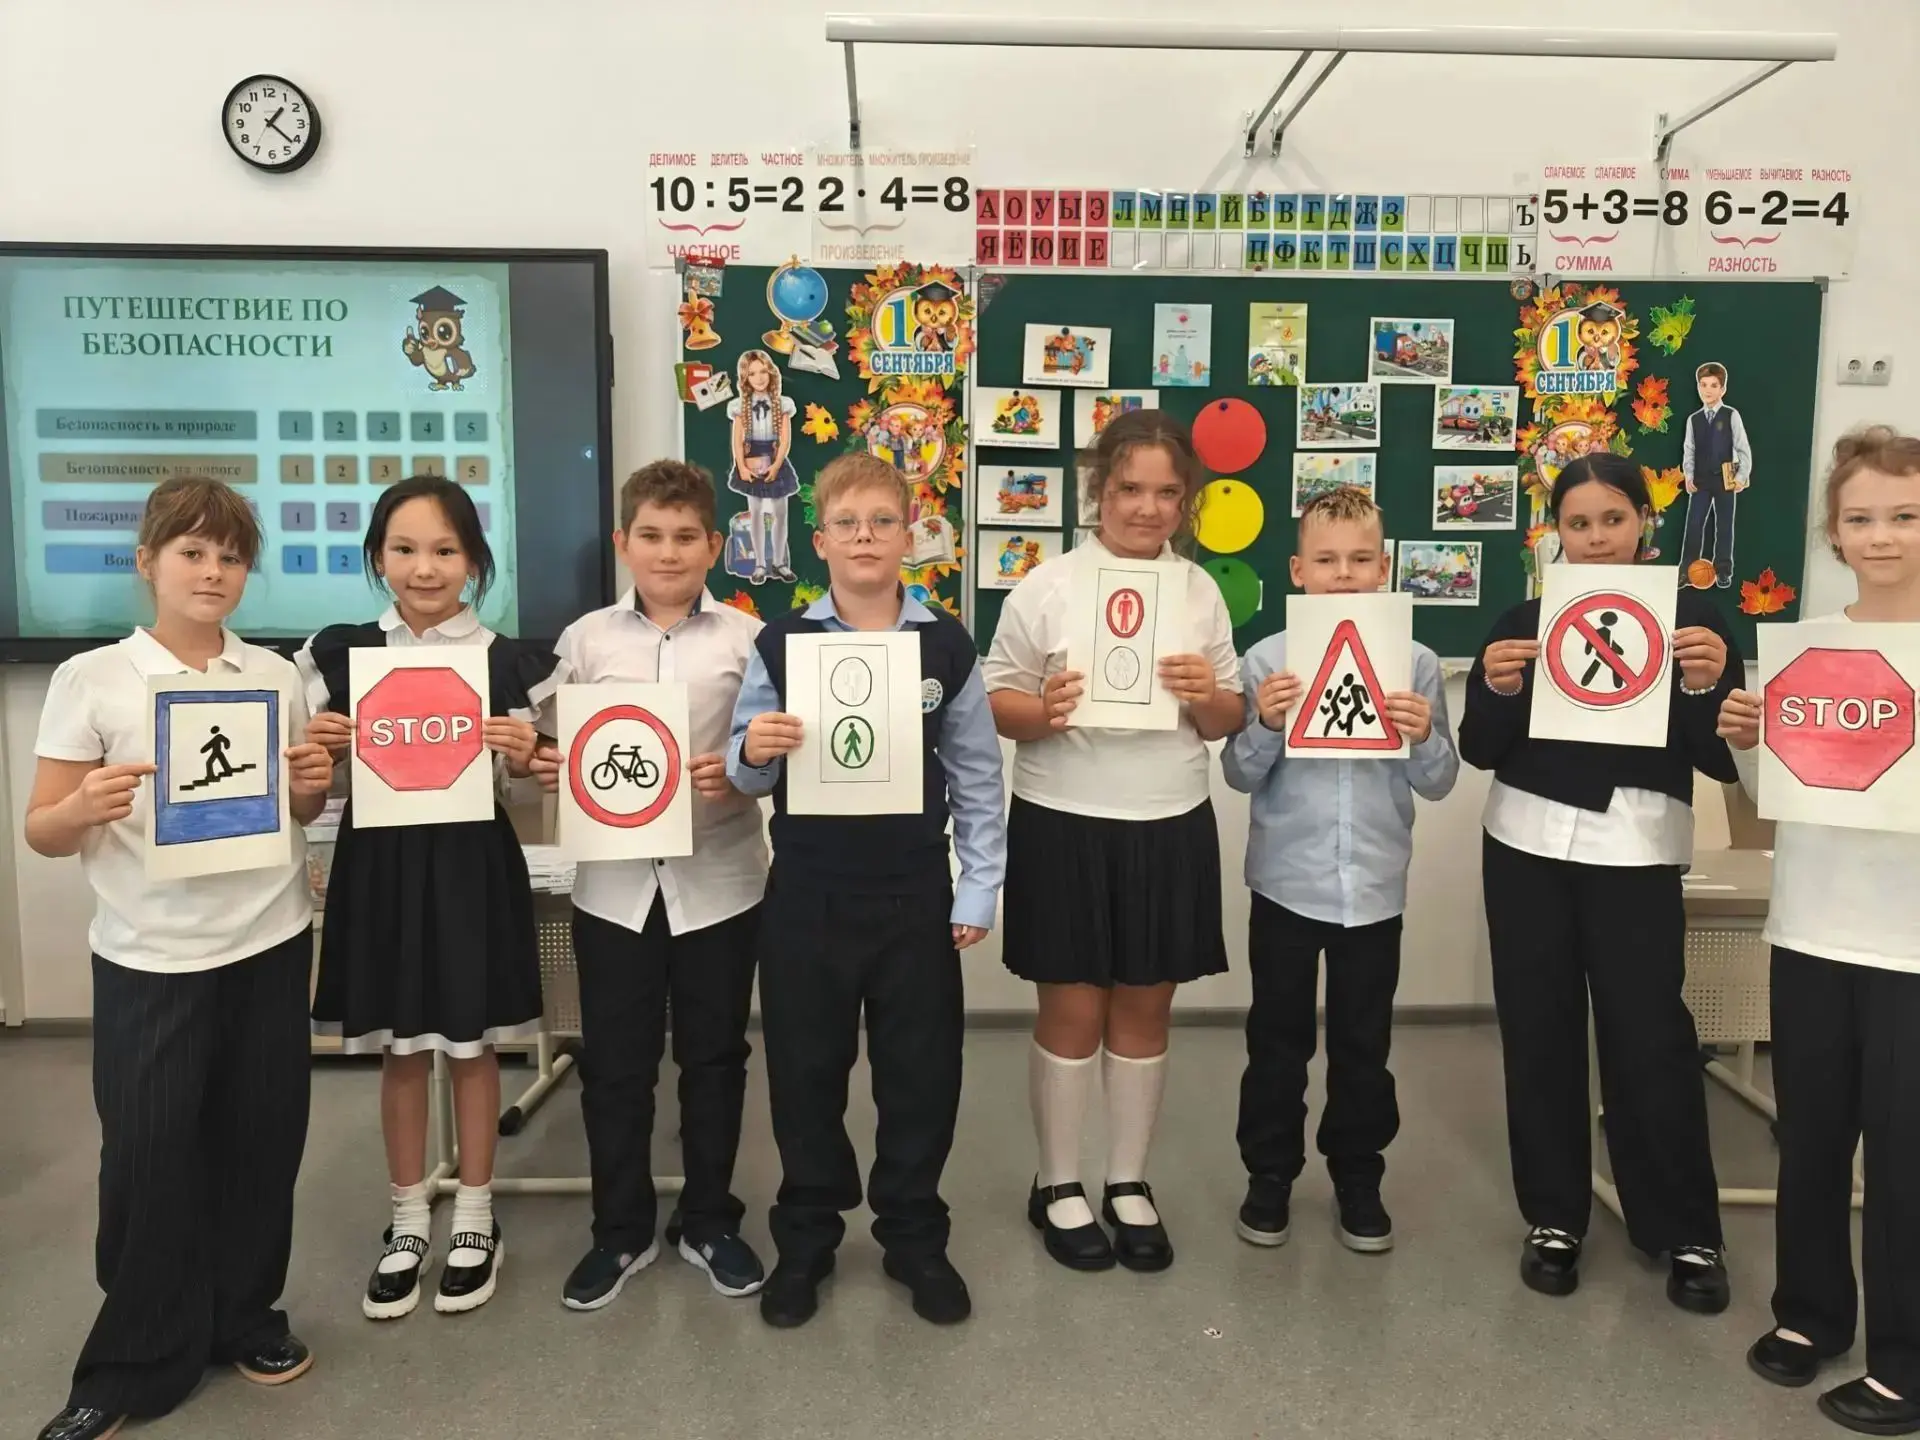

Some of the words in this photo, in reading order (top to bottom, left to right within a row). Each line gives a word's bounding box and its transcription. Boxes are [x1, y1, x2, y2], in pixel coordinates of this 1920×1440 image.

[249, 92, 258, 102] 11
[262, 88, 276, 98] 12
[282, 92, 287, 102] 1
[239, 103, 252, 112] 10
[292, 103, 300, 112] 2
[236, 119, 244, 128] 9
[296, 119, 305, 128] 3
[241, 134, 249, 143] 8
[293, 135, 301, 144] 4
[253, 146, 260, 155] 7
[268, 150, 276, 159] 6
[283, 146, 292, 155] 5
[649, 153, 696, 167] ДЕЛИМОЕ
[711, 153, 748, 166] ДЕЛИТЕЛЬ
[761, 153, 804, 166] ЧАСТНОЕ
[1544, 166, 1586, 179] СЛАГАЕМОЕ
[1594, 166, 1636, 180] СЛАГАЕМОЕ
[1660, 168, 1689, 181] СУММА
[1760, 168, 1802, 181] ВЫЧИТАЕМОЕ
[1811, 169, 1851, 182] РАЗНОСТЬ
[979, 197, 998, 219] А
[1006, 197, 1022, 219] О
[1034, 197, 1051, 220] У
[1058, 197, 1081, 220] Ы
[1090, 197, 1105, 221] Э
[1114, 199, 1133, 221] Л
[1142, 199, 1162, 222] М
[1168, 199, 1187, 222] Н
[1195, 200, 1211, 222] Р
[1223, 196, 1241, 223] Й
[1250, 201, 1265, 224] Б
[1279, 201, 1294, 224] В
[1305, 201, 1320, 224] Г
[1330, 201, 1349, 229] Д
[1355, 201, 1378, 225] Ж
[1385, 201, 1399, 226] З
[1517, 204, 1534, 226] Ъ
[667, 243, 740, 260] ЧАСТНОЕ
[820, 244, 905, 261] ПРОИЗВЕДЕНИЕ
[980, 236, 998, 259] Я
[1008, 231, 1023, 259] Ё
[1031, 236, 1054, 260] Ю
[1060, 237, 1078, 260] И
[1088, 237, 1105, 261] Е
[1249, 240, 1269, 263] П
[1275, 240, 1296, 263] Ф
[1304, 240, 1320, 263] К
[1330, 241, 1348, 264] Т
[1353, 242, 1376, 265] Ш
[1384, 242, 1399, 265] С
[1409, 243, 1428, 264] Х
[1435, 243, 1454, 269] Ц
[1463, 243, 1479, 265] Ч
[1486, 244, 1508, 269] Щ
[1517, 244, 1532, 266] Ь
[1555, 255, 1613, 272] СУММА
[1708, 256, 1777, 273] РАЗНОСТЬ
[64, 295, 293, 322] ПУТЕШЕСТВИЕ
[302, 298, 349, 322] ПО
[888, 300, 913, 348] 1
[81, 331, 334, 358] БЕЗОПАСНОСТИ
[1552, 320, 1574, 368] 1
[871, 352, 955, 374] СЕНТЯБРЯ
[1536, 370, 1616, 394] СЕНТЯБРЯ
[56, 416, 160, 431] Безопасность
[165, 421, 173, 430] в
[178, 421, 236, 435] природе
[293, 421, 299, 433] 1
[336, 421, 344, 434] 2
[380, 421, 388, 434] 3
[424, 422, 432, 434] 4
[468, 422, 476, 435] 5
[66, 461, 170, 475] Безопасность
[294, 465, 300, 477] 1
[338, 465, 346, 478] 2
[382, 465, 390, 478] 3
[468, 465, 476, 478] 5
[65, 508, 138, 525] Пожарна
[296, 512, 300, 524] 1
[339, 512, 348, 524] 2
[298, 555, 302, 567] 1
[341, 555, 348, 567] 2
[1779, 696, 1899, 730] STOP
[370, 715, 473, 746] STOP
